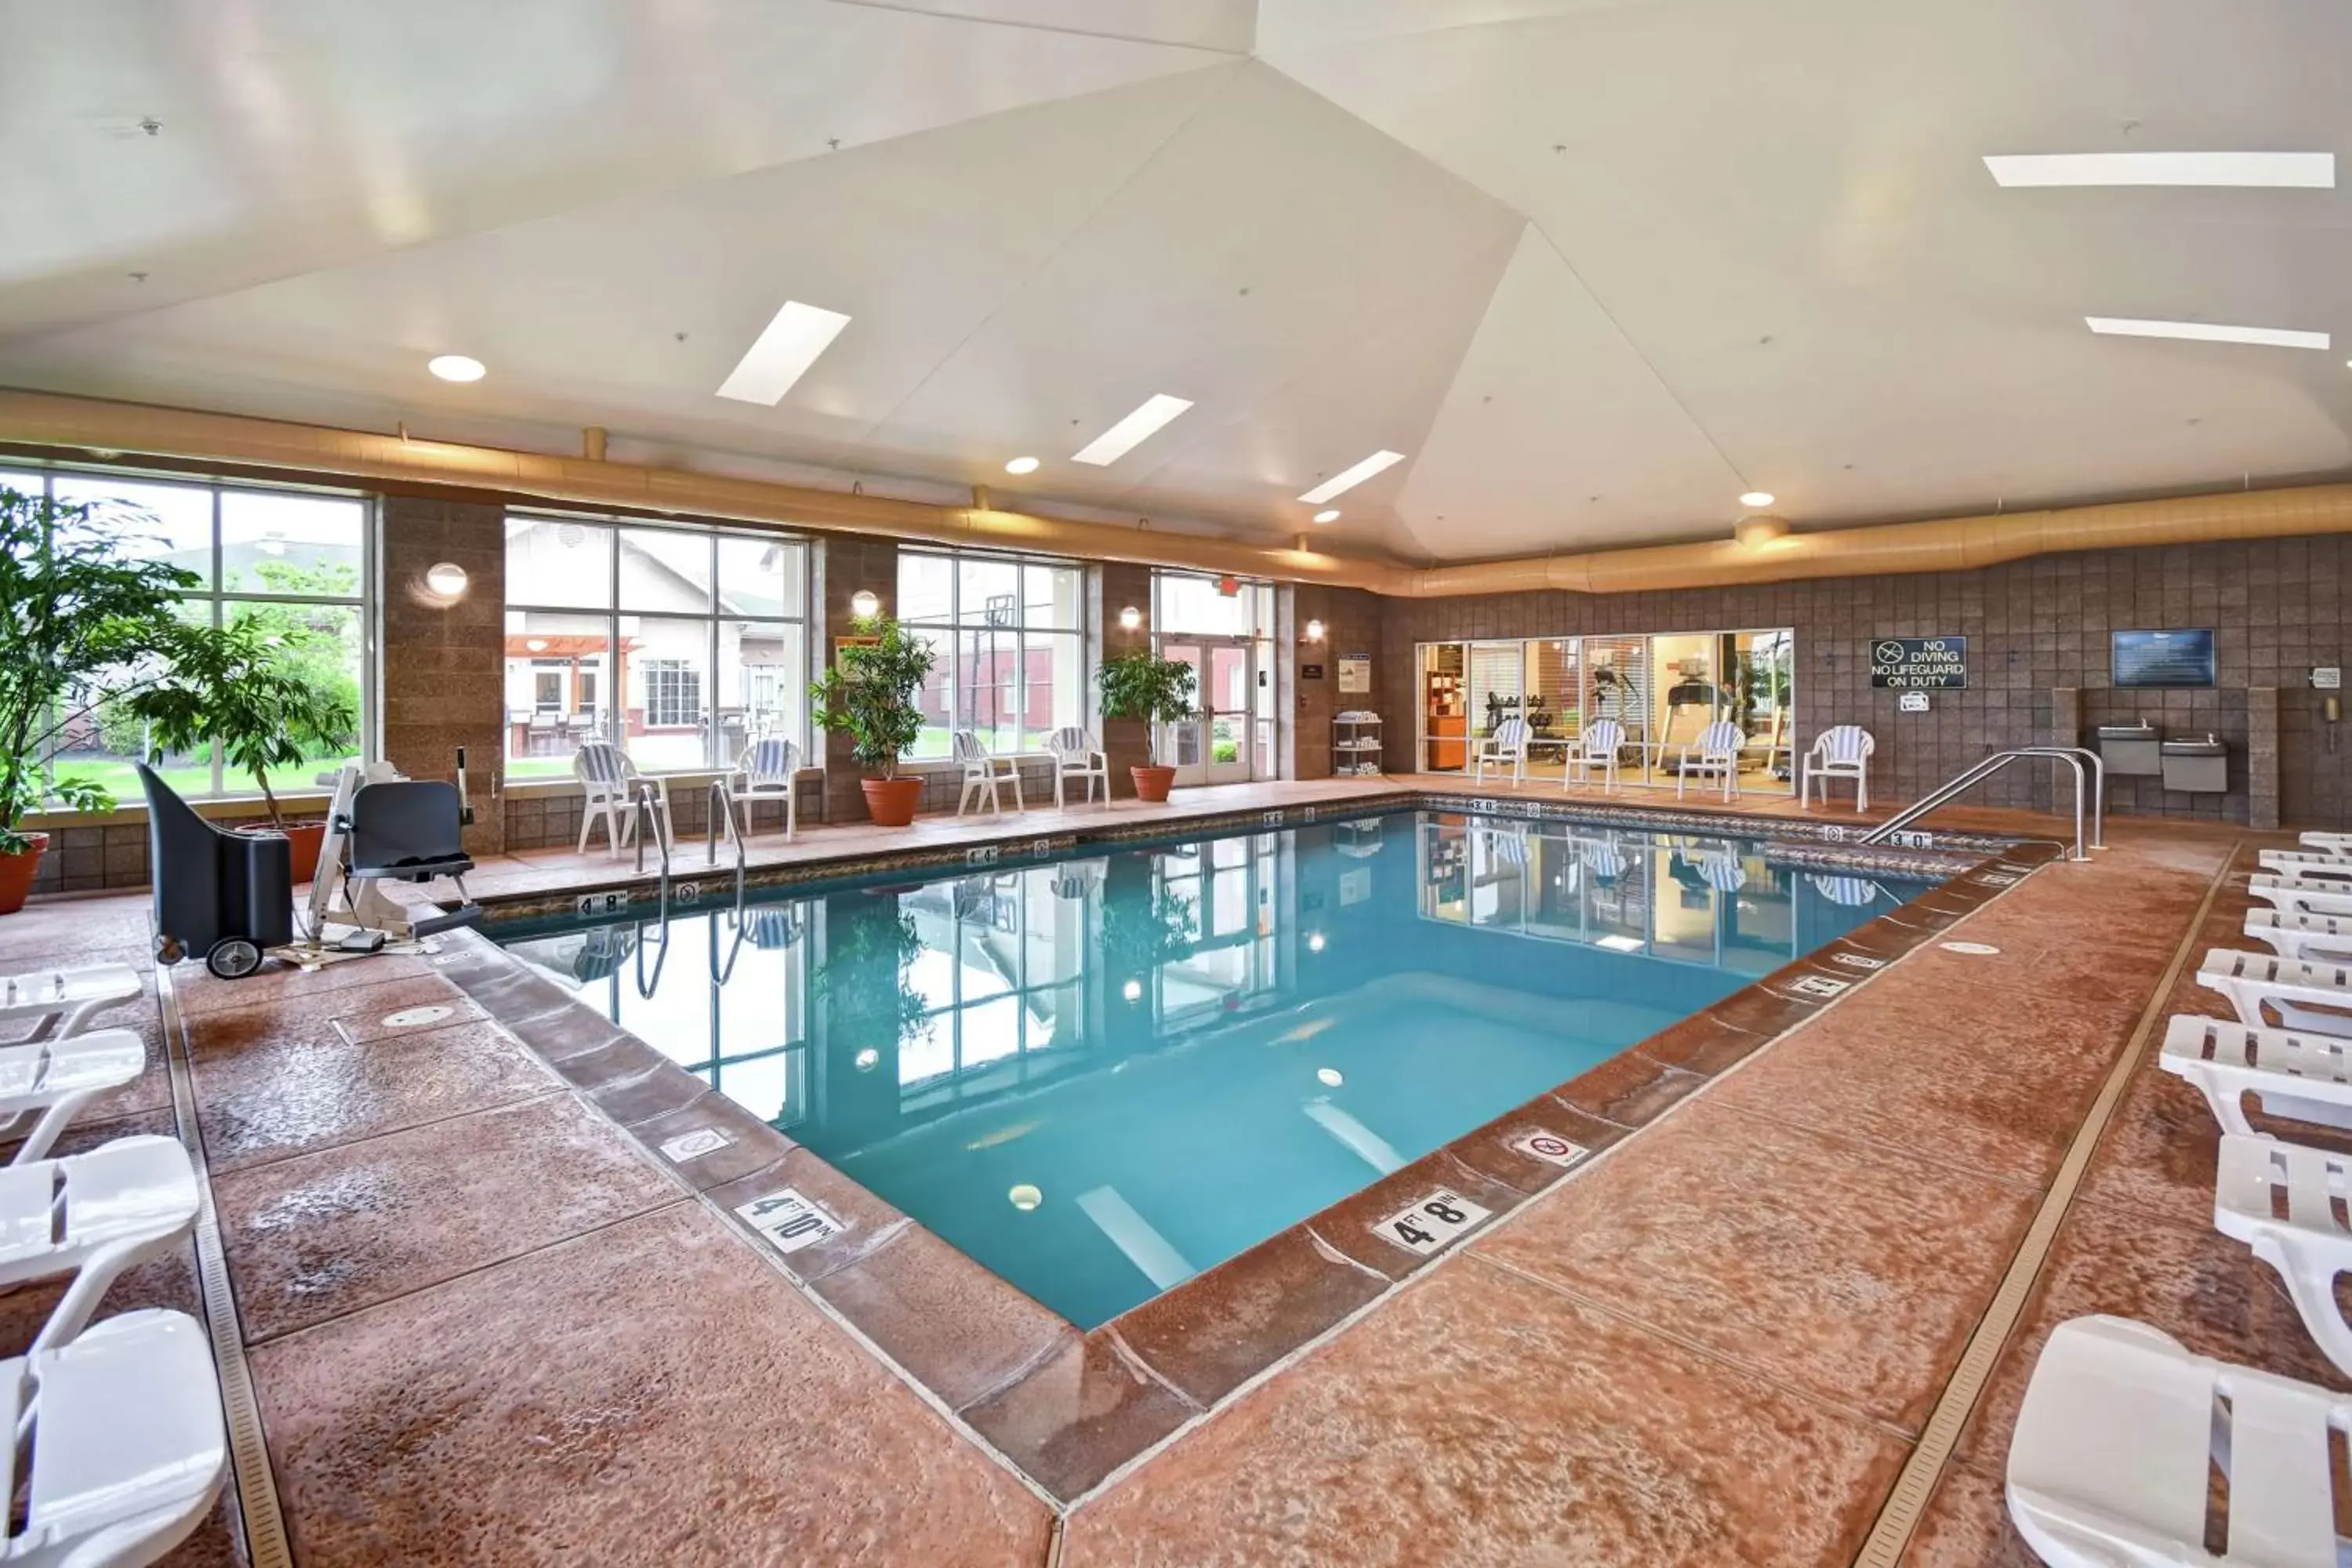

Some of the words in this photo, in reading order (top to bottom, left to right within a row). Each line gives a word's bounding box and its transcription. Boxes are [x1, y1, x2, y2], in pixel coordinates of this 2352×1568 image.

[1923, 641, 1945, 652] NO
[1911, 652, 1959, 662] DIVING
[1871, 666, 1890, 676] NO
[1892, 664, 1964, 675] LIFEGUARD
[1887, 676, 1907, 687] ON
[1911, 675, 1947, 687] DUTY
[1893, 833, 1902, 846] 3
[752, 1197, 795, 1216] 4
[773, 1213, 822, 1240] 10
[1393, 1221, 1437, 1246] 4
[1424, 1202, 1468, 1225] 8
